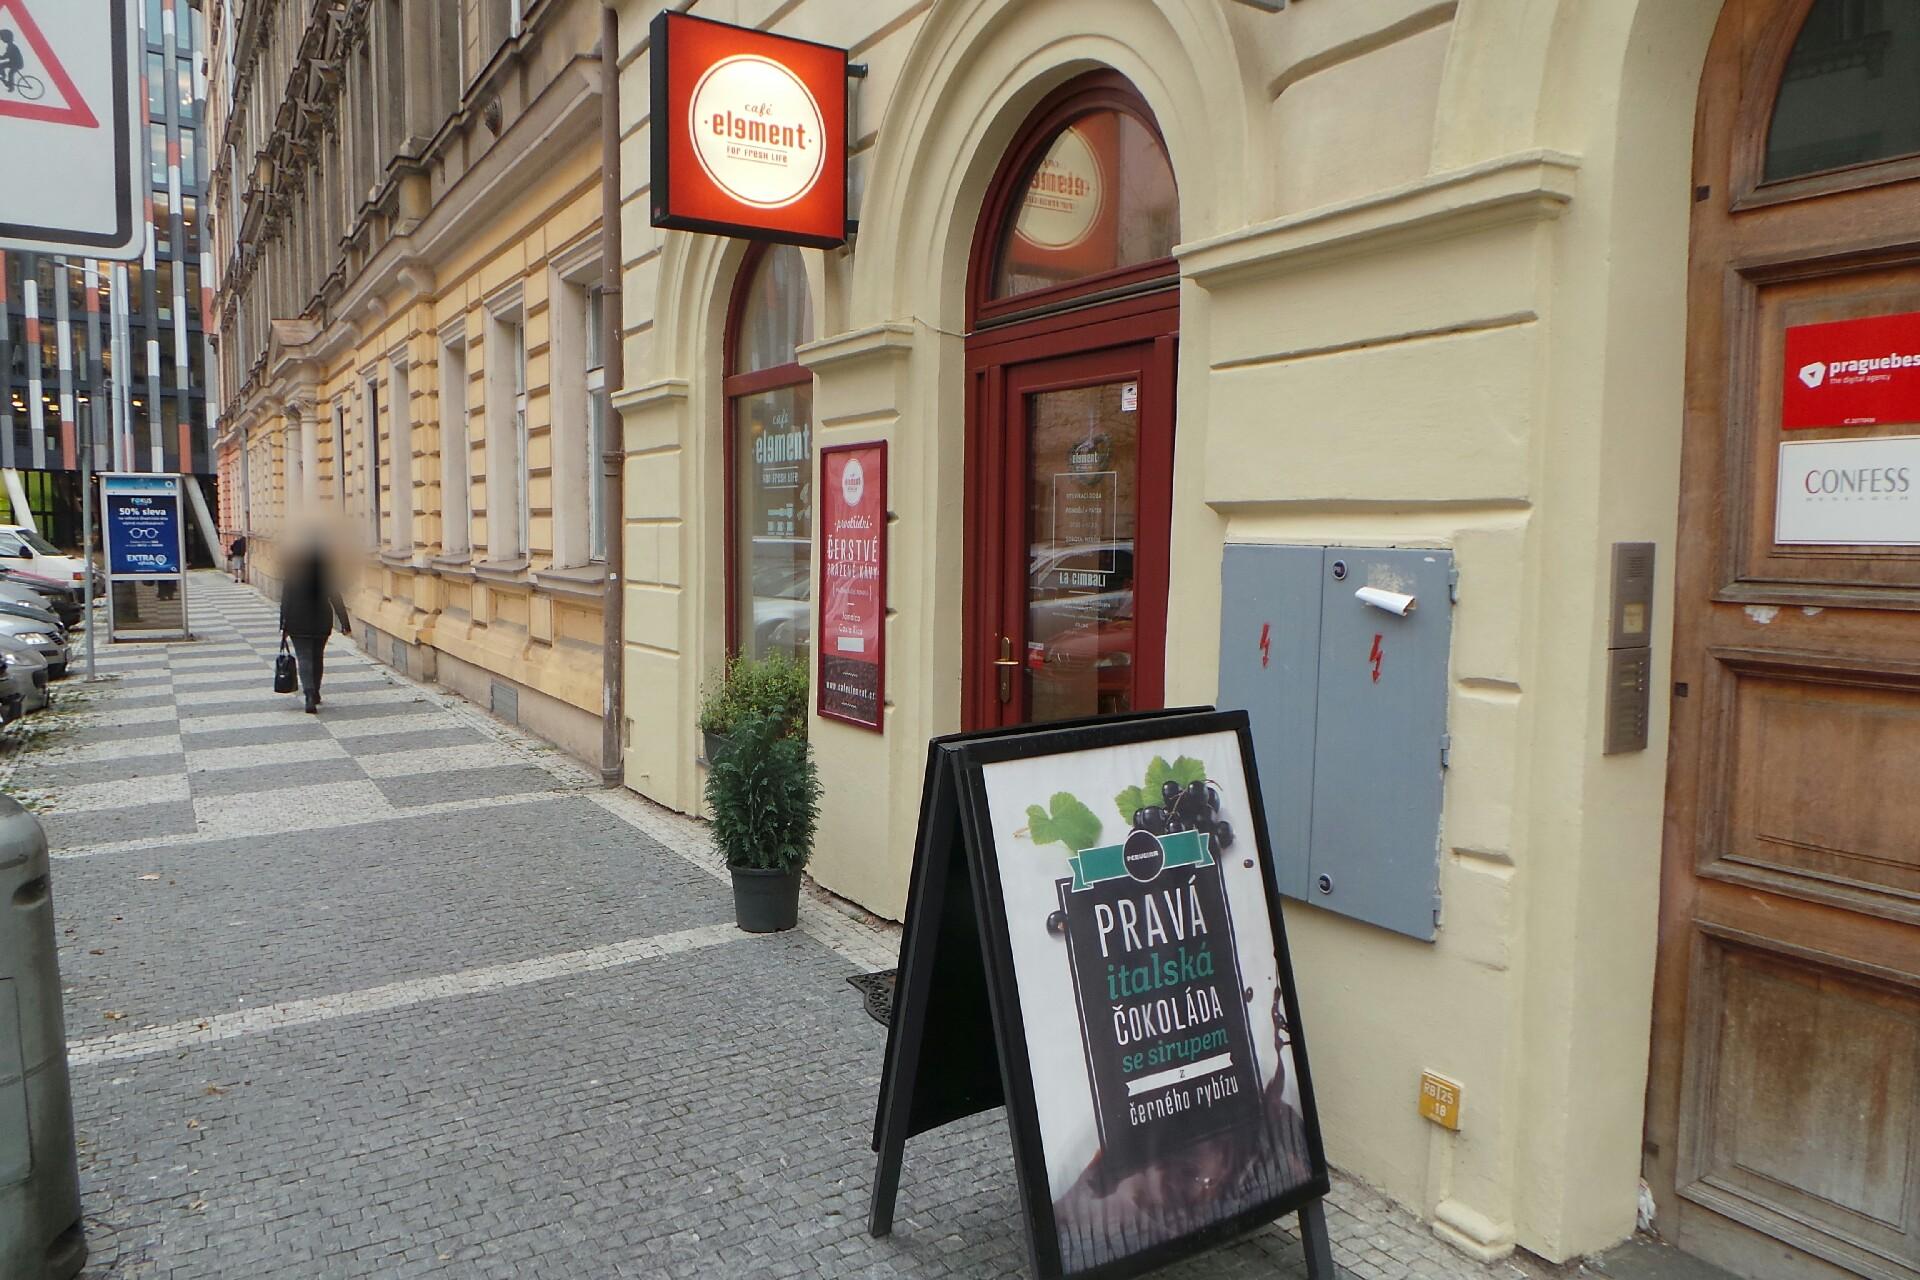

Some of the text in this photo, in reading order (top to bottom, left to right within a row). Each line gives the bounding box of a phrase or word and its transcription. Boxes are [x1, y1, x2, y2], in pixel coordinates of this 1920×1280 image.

[744, 102, 773, 117] café
[1842, 375, 1865, 385] digital
[1866, 374, 1892, 383] agency
[1805, 467, 1910, 494] CONFESS
[119, 507, 167, 516] 50% sleva
[126, 554, 155, 562] EXTRA
[827, 534, 878, 562] ČERSTVÉ
[1094, 874, 1208, 958] PRAVÁ
[1107, 941, 1215, 1001] italská
[1112, 985, 1224, 1046] ČOKOLÁDA
[1122, 1028, 1229, 1073] se sirupem
[1129, 1074, 1239, 1126] černého rybízu
